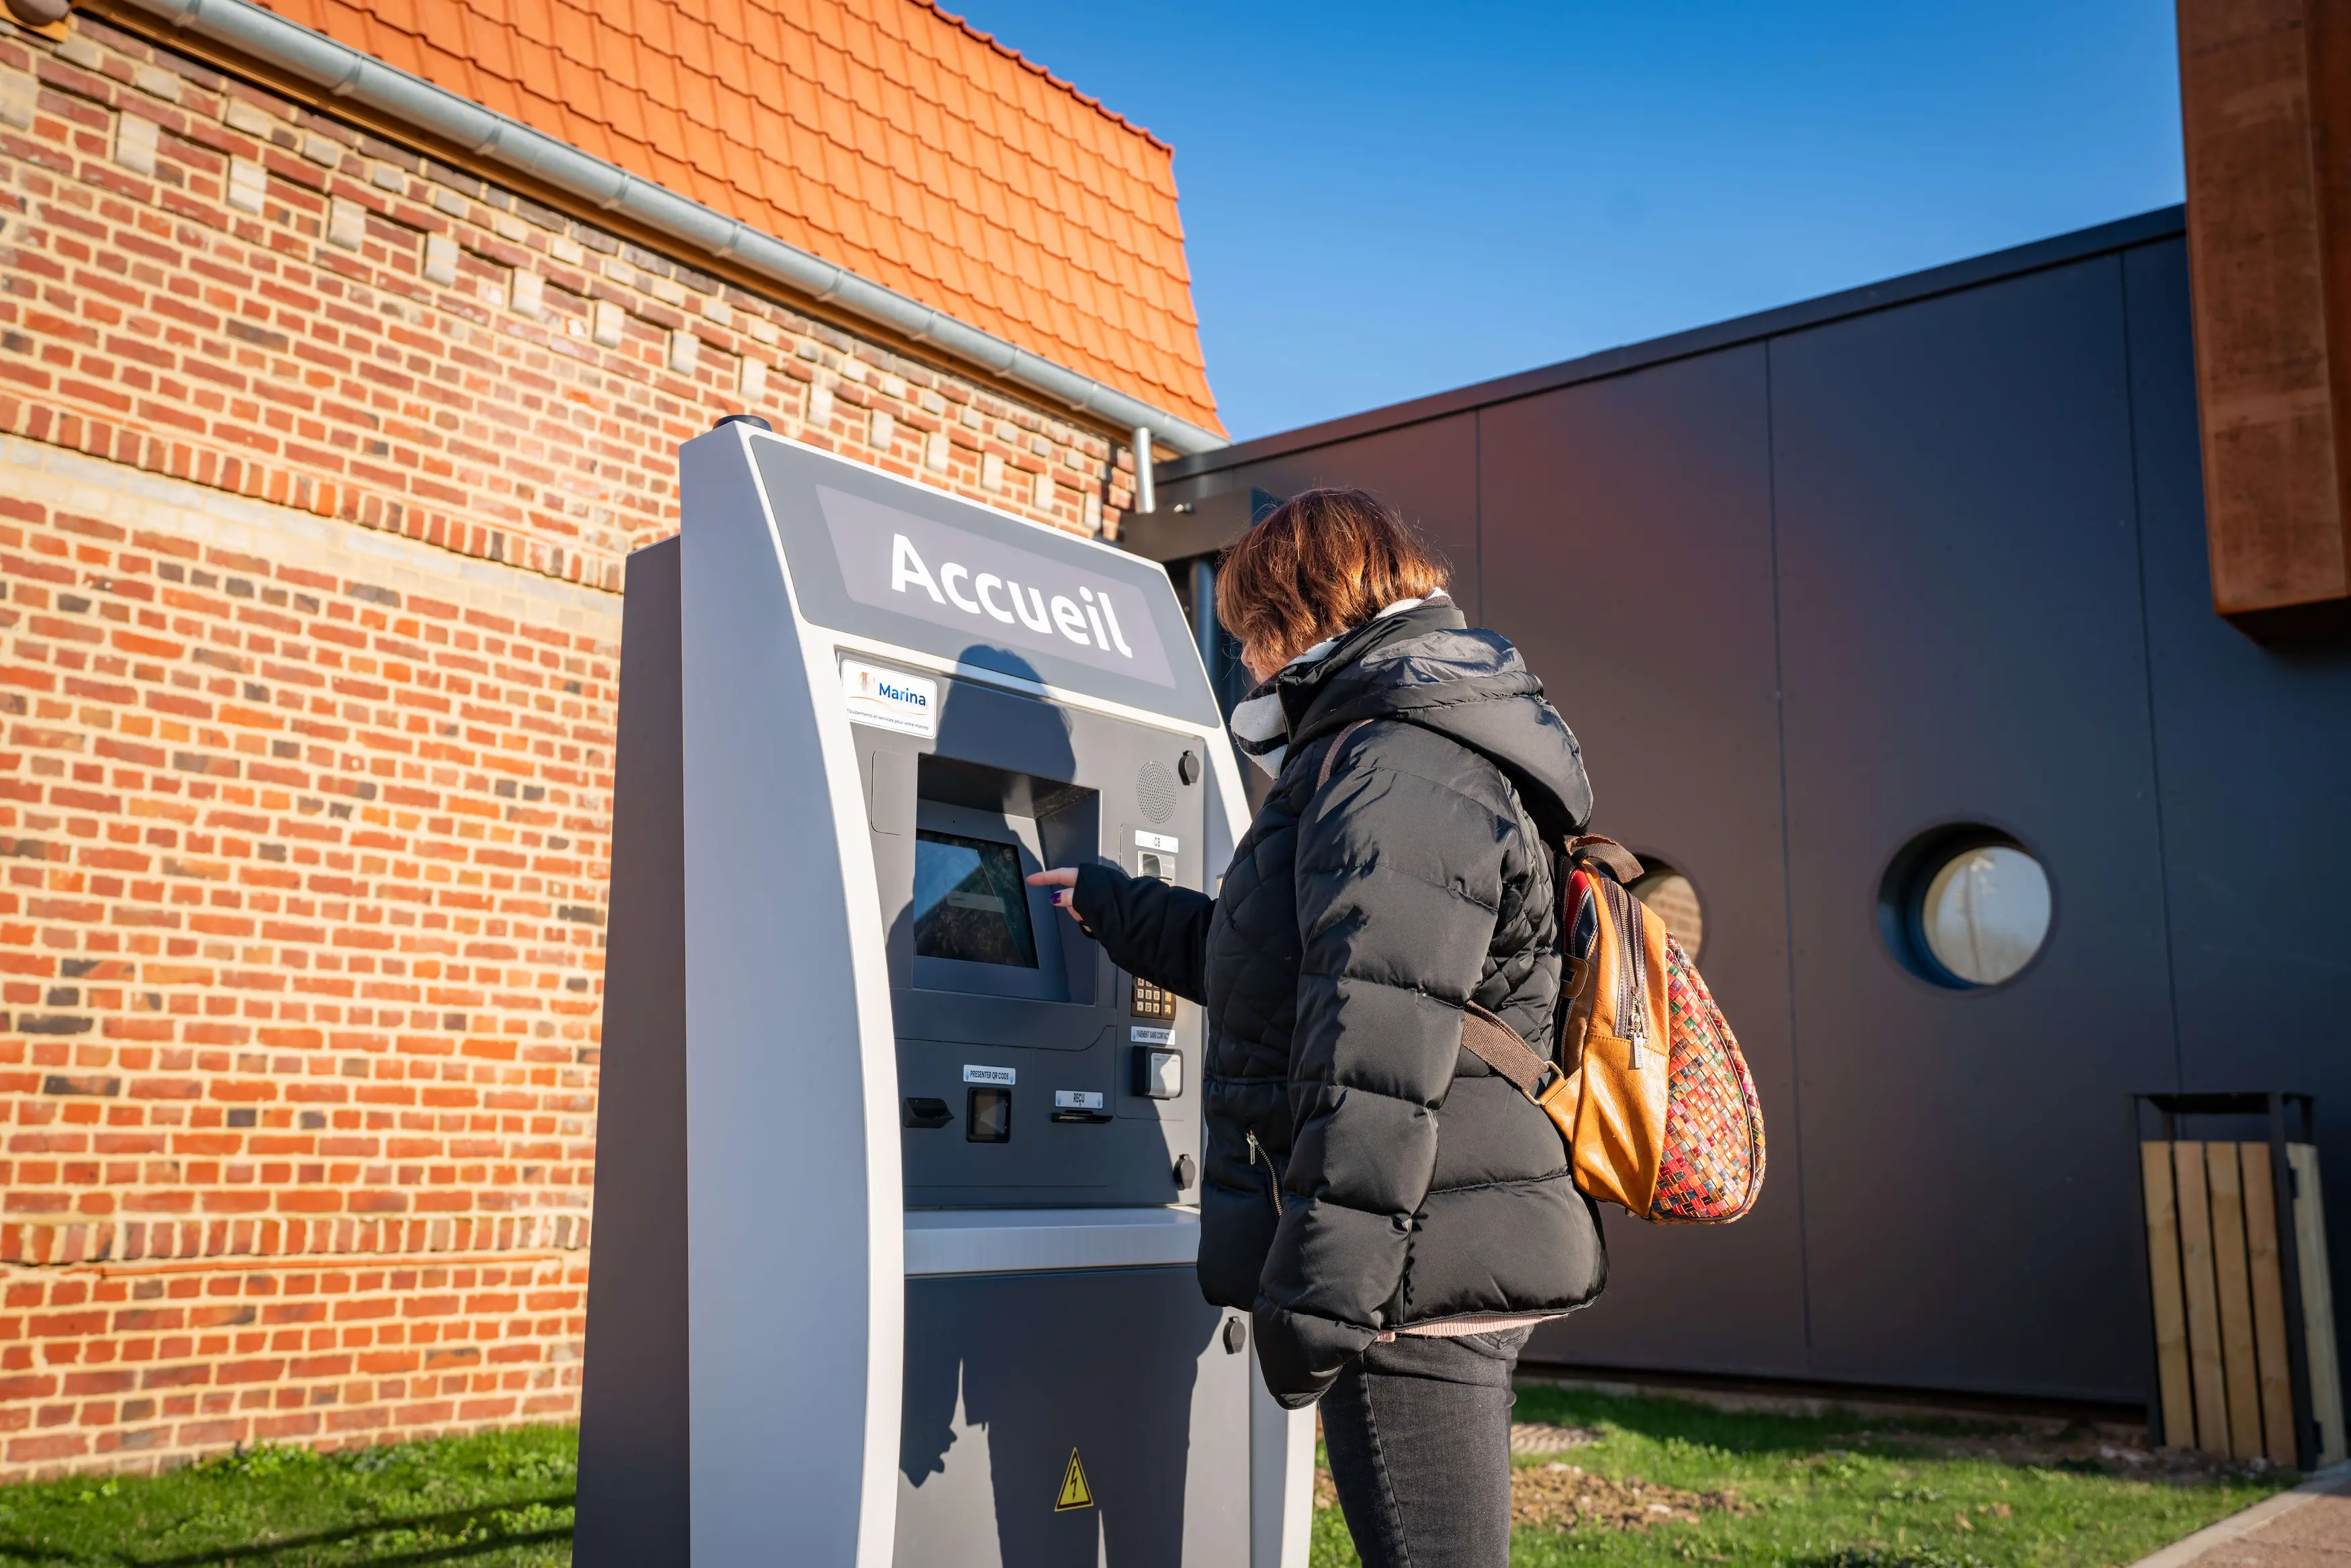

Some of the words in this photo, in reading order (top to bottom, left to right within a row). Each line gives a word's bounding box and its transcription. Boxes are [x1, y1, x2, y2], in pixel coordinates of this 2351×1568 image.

[891, 533, 1133, 658] Accueil
[879, 682, 926, 706] Marina
[970, 1070, 991, 1079] PRESENTER
[991, 1072, 997, 1080] QR
[1073, 1093, 1085, 1107] REÇU
